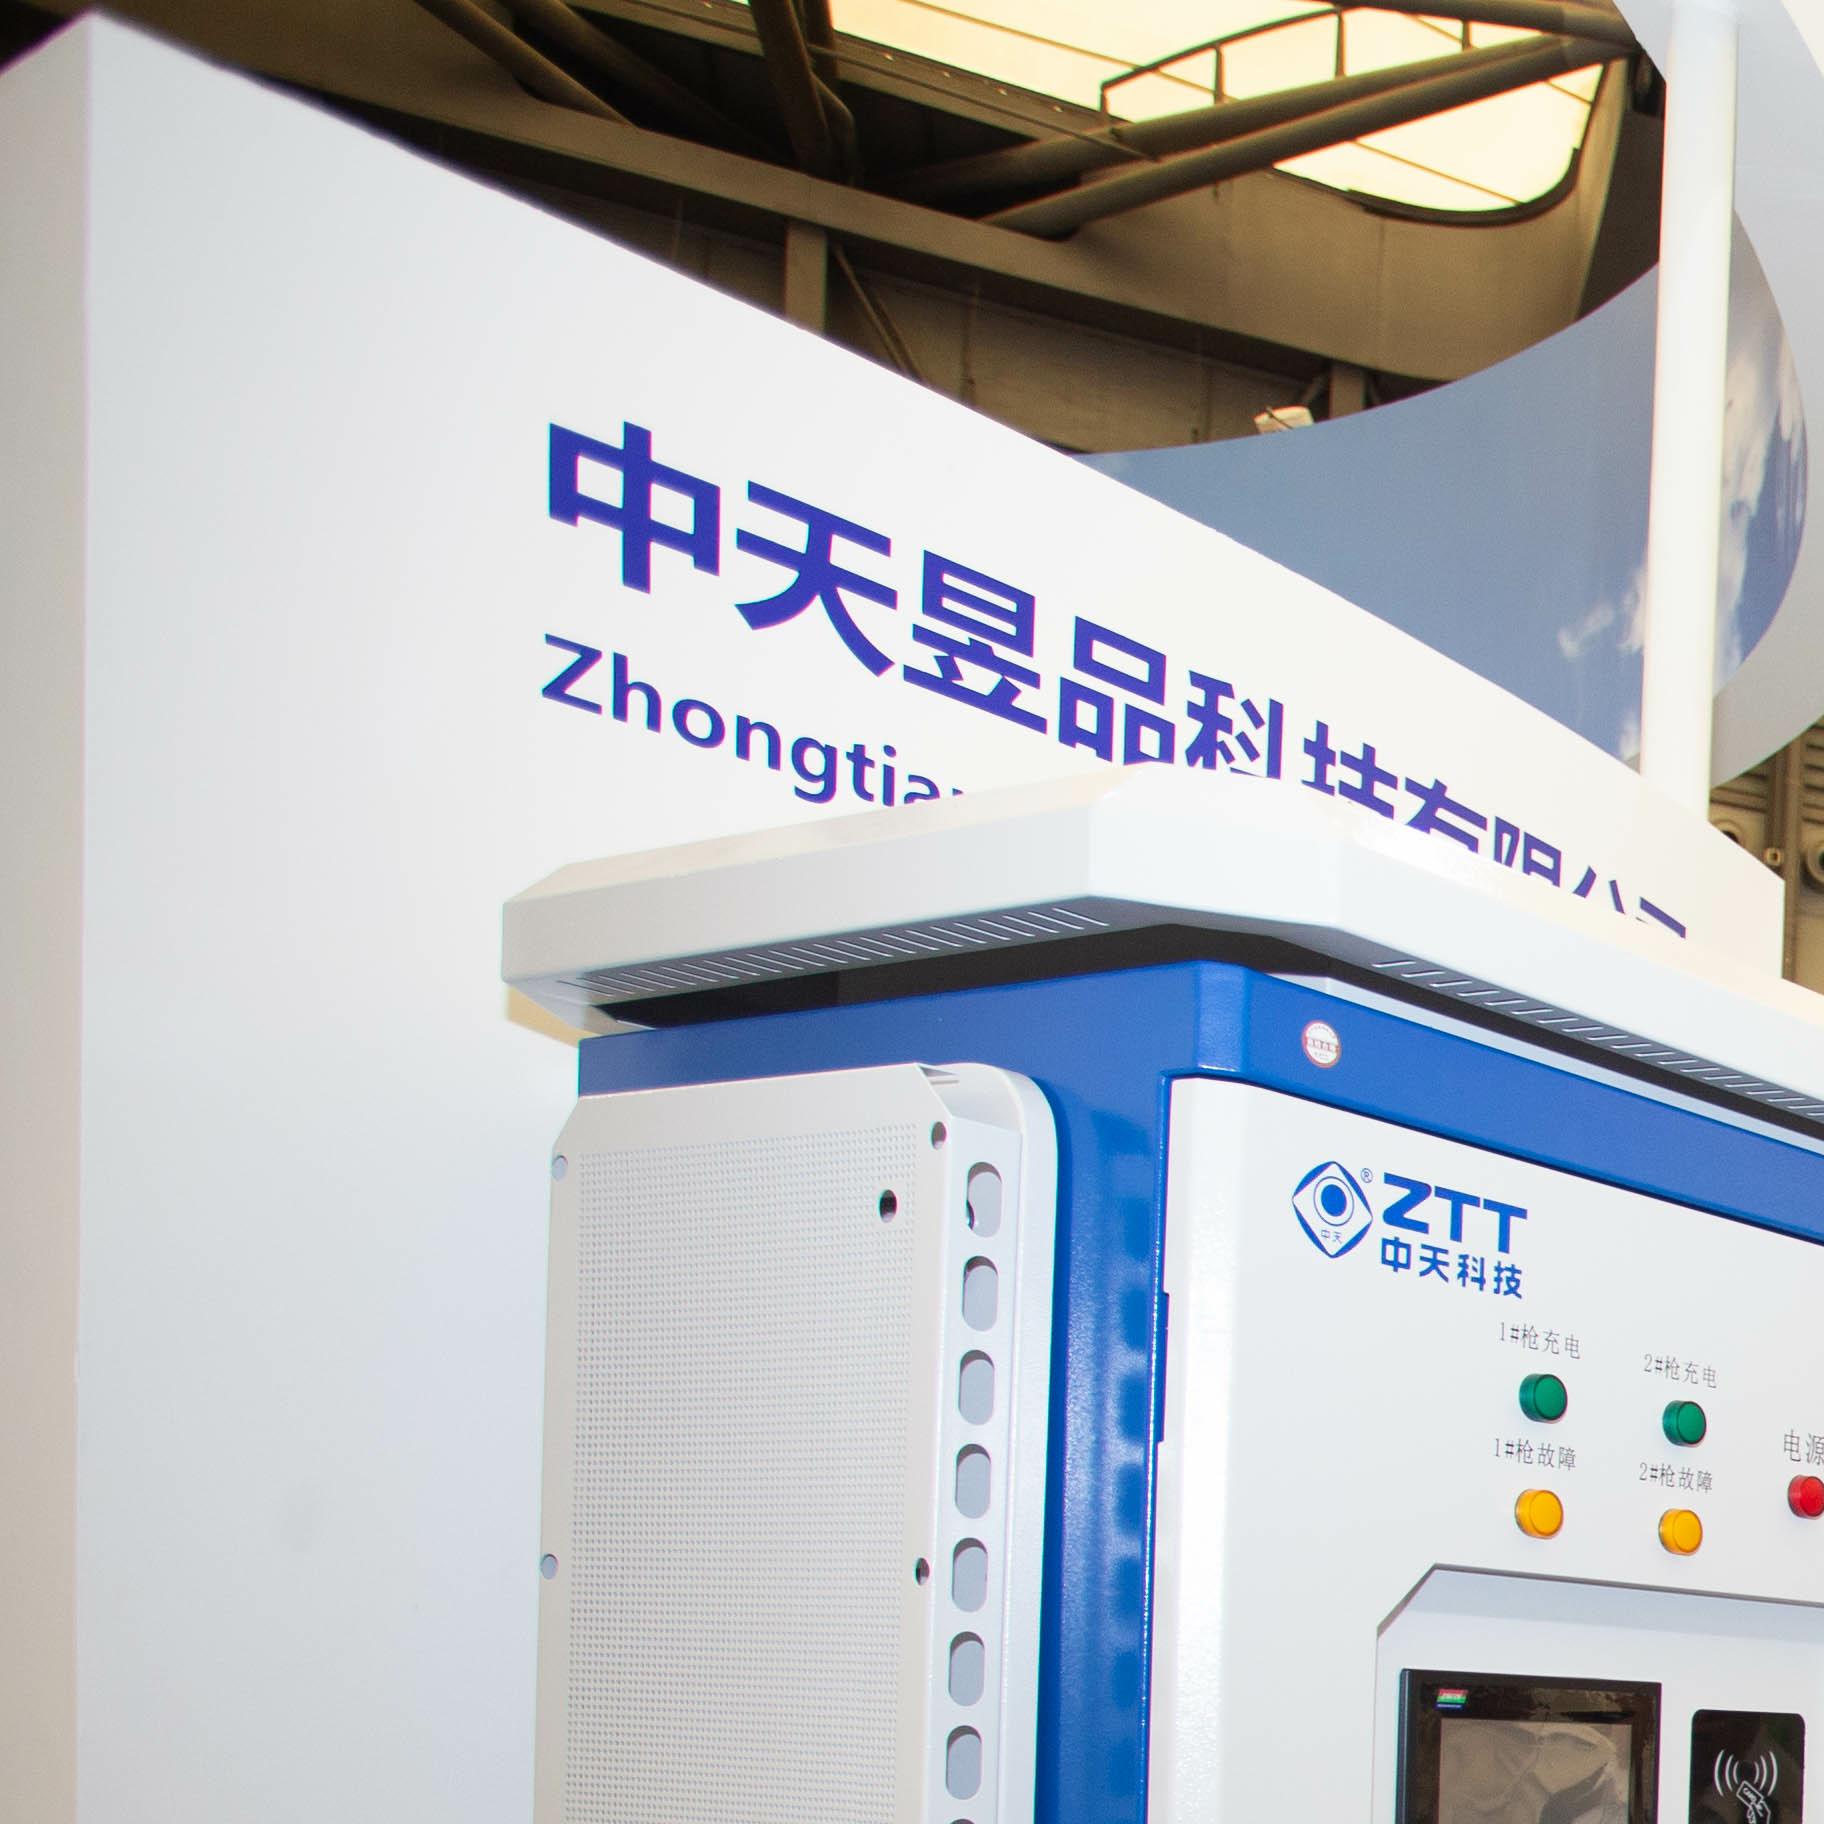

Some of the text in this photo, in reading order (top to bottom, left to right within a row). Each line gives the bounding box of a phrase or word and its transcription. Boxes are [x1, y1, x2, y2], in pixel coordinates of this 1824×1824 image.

[541, 632, 964, 806] Zhongtia
[1382, 1171, 1528, 1255] ZTT
[1380, 1236, 1523, 1300] 中天科技
[1499, 1322, 1581, 1360] 1#枪充电
[1643, 1354, 1718, 1389] 2#枪充电
[1494, 1437, 1577, 1471] 1#枪故障
[1638, 1461, 1713, 1494] 2#枪故障
